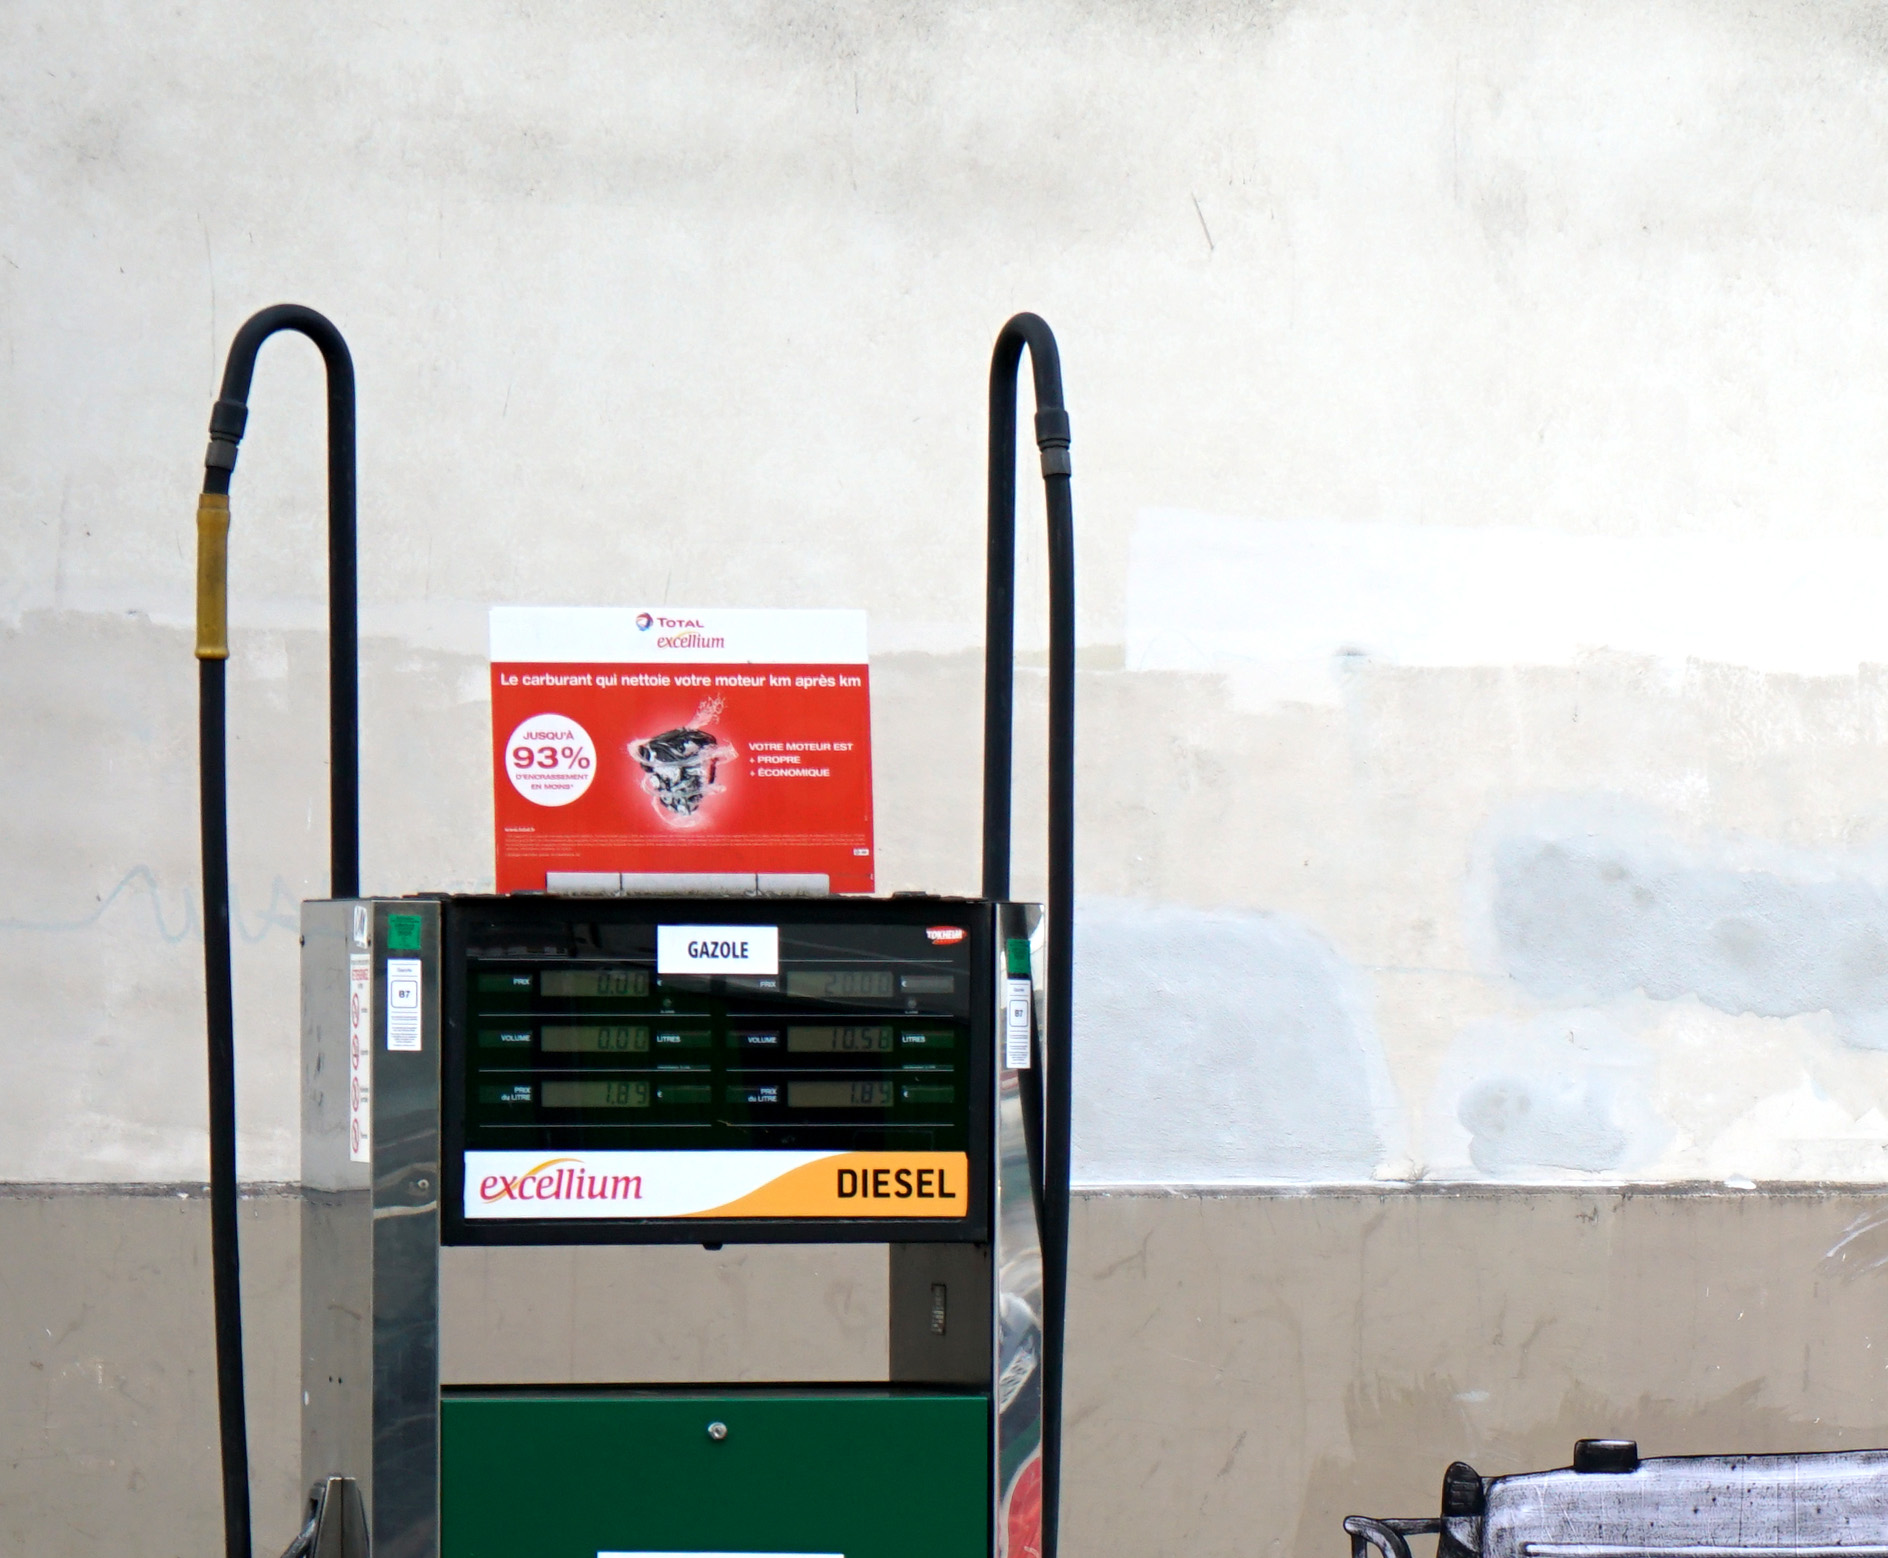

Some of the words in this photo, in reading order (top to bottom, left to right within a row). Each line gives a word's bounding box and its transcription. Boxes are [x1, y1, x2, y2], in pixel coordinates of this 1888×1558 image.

[656, 617, 704, 628] TOTAL
[656, 633, 725, 649] excellium
[500, 673, 519, 686] Le
[522, 673, 593, 686] carburant
[596, 673, 617, 689] qui
[621, 673, 671, 686] nettoie
[674, 674, 711, 687] votre
[715, 674, 766, 687] moteur
[769, 674, 791, 687] km
[795, 674, 836, 690] après
[839, 674, 861, 687] km
[523, 730, 574, 740] JUSQU'À
[748, 742, 784, 751] VOTRE
[786, 742, 831, 751] MOTEUR
[833, 743, 854, 751] EST
[512, 746, 591, 769] 93%
[757, 755, 801, 764] PROPRE
[758, 766, 831, 777] ÉCONOMIQUE
[687, 941, 749, 959] GAZOLE
[513, 977, 530, 986] PRIX
[398, 990, 411, 999] B7
[501, 1034, 531, 1042] VOLUME
[656, 1035, 681, 1043] LITRES
[748, 1036, 777, 1044] VOLUME
[902, 1035, 926, 1043] LITRES
[514, 1086, 531, 1094] PRIX
[479, 1167, 642, 1201] excellium
[837, 1168, 956, 1199] DIESEL
